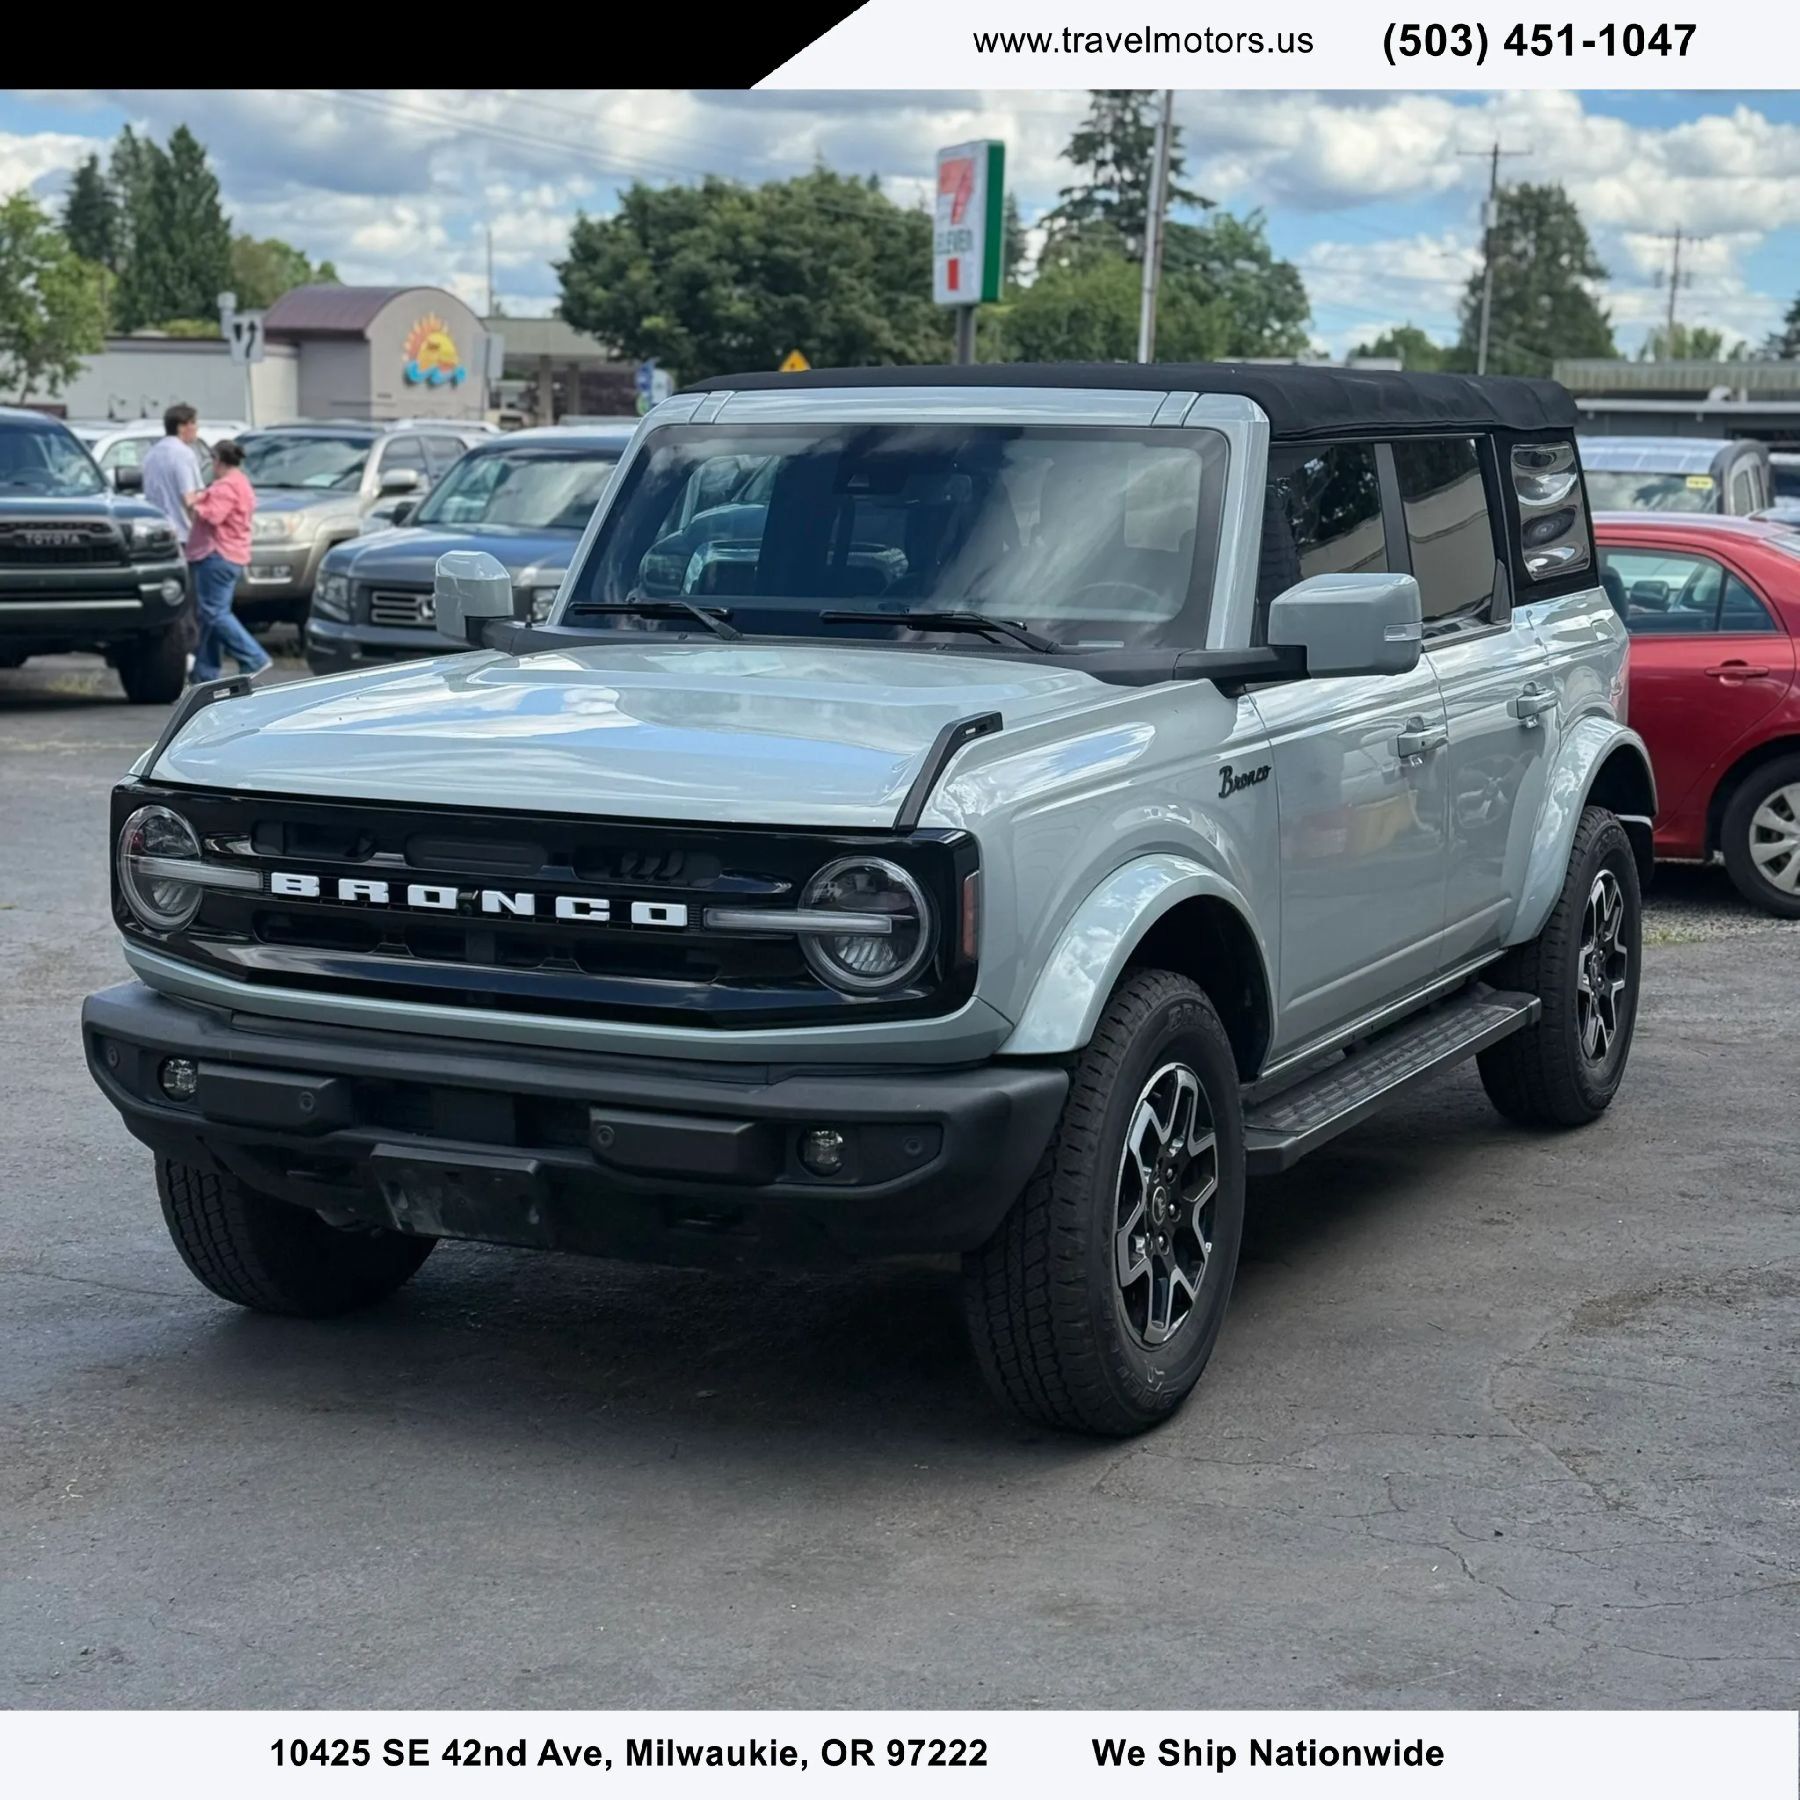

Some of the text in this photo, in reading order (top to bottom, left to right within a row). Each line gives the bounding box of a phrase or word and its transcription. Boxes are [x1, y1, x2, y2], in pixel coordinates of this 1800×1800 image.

[24, 532, 80, 546] TOYOTA
[1218, 765, 1272, 799] Bronco
[271, 872, 688, 927] BRONCO
